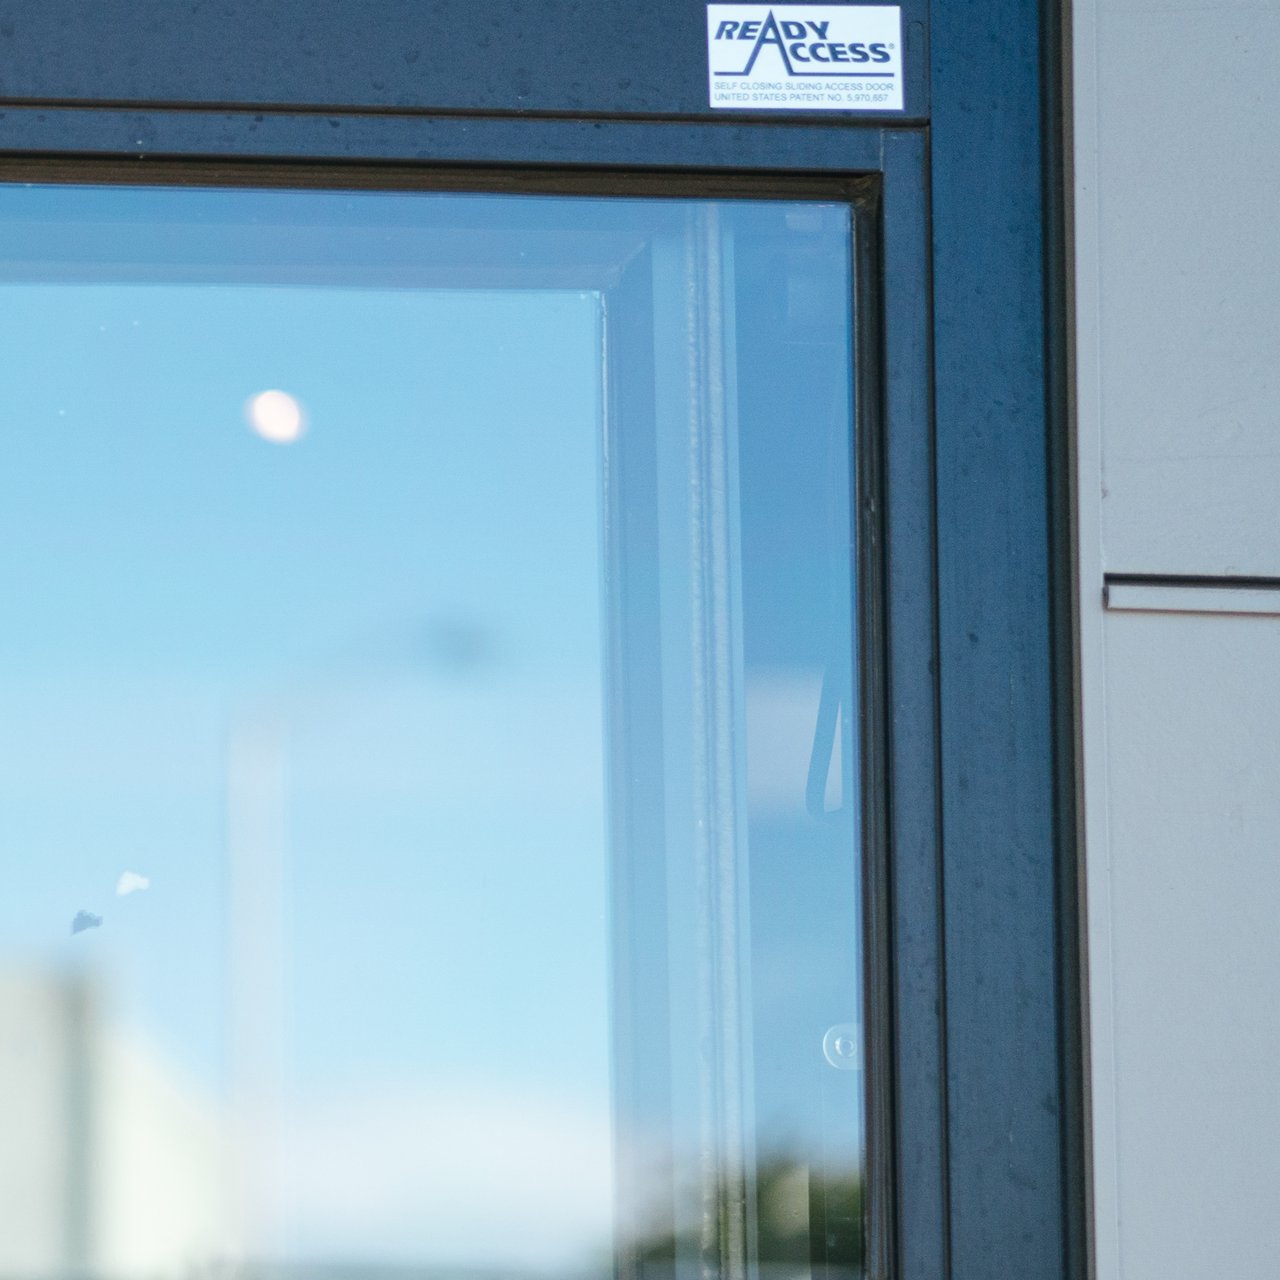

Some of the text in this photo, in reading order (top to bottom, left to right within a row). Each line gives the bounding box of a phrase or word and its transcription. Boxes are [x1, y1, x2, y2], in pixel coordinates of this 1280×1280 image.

[714, 10, 830, 45] READY
[714, 82, 895, 92] SELF CLOSING SLIDING ACCESS DOOR
[714, 93, 750, 102] UNITED
[752, 93, 788, 102] STATES
[789, 93, 826, 102] PATENT
